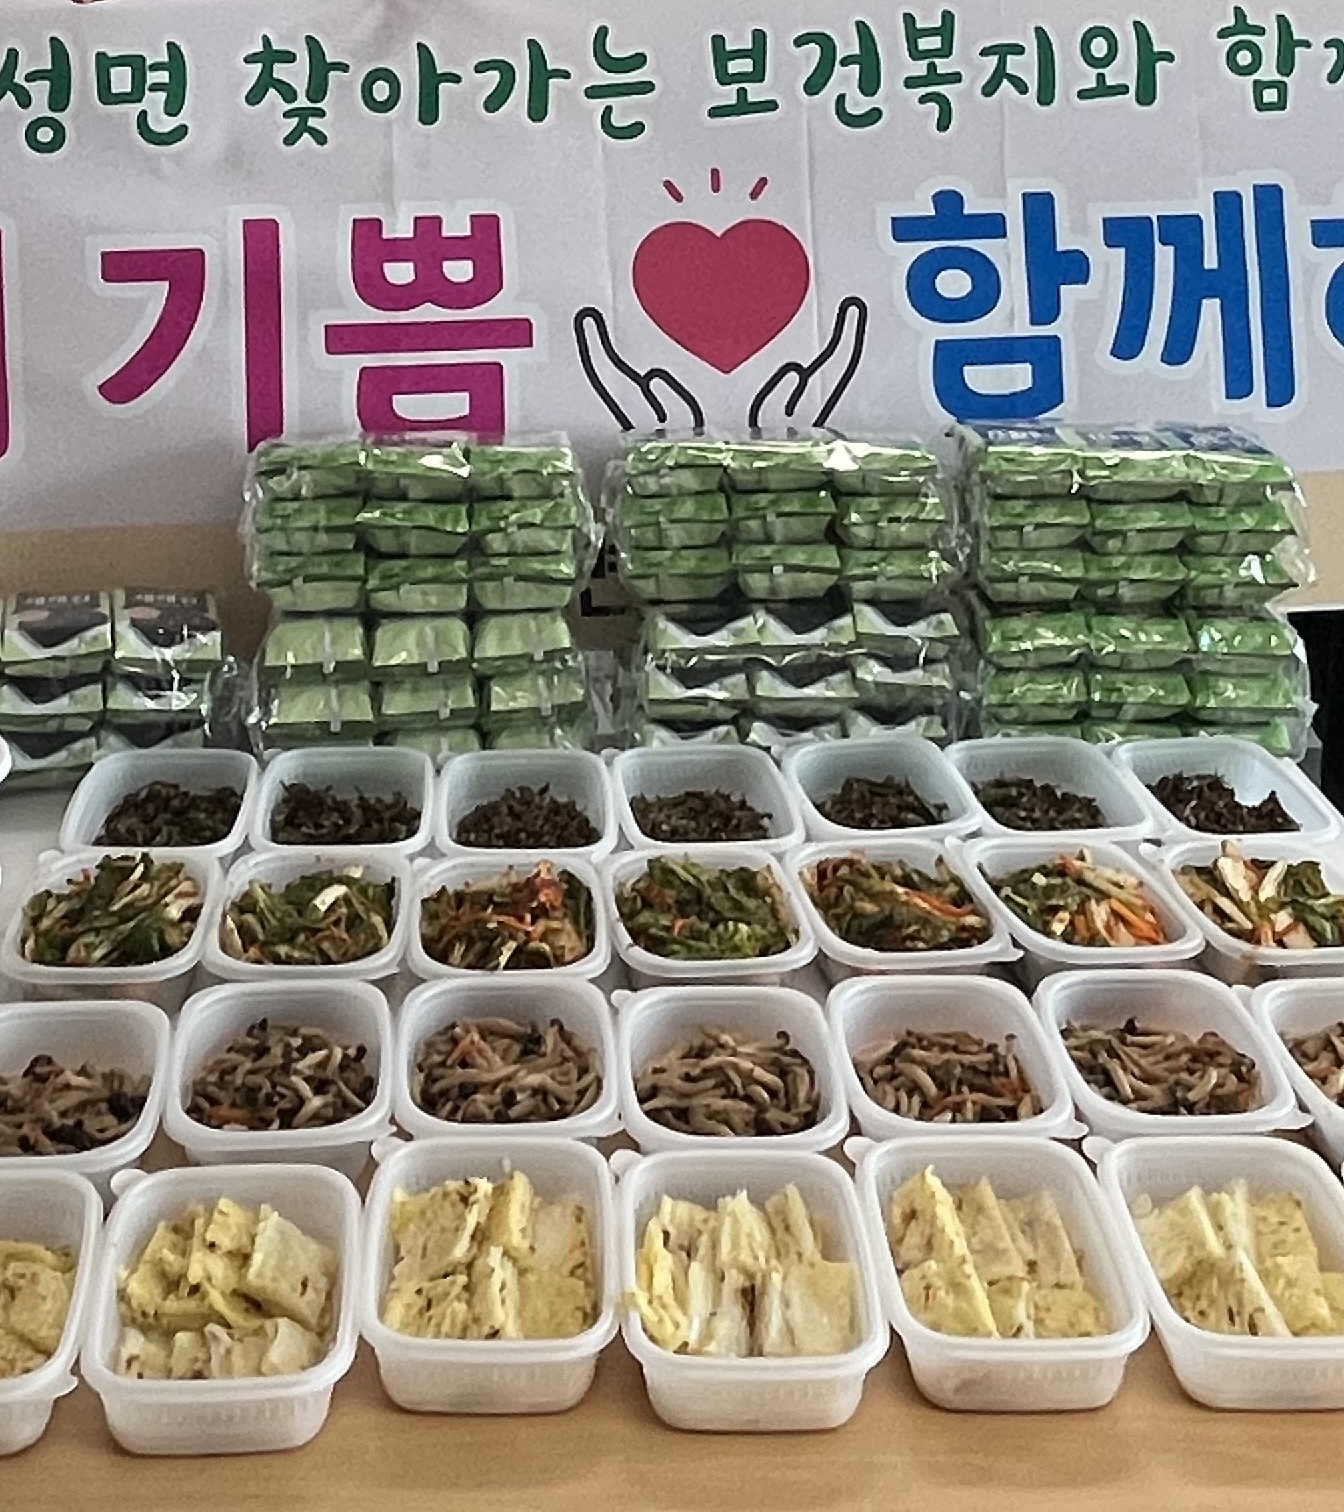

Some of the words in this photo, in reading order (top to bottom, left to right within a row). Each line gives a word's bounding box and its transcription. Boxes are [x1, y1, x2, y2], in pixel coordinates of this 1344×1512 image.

[244, 26, 656, 147] 찾아가는
[707, 10, 1176, 140] 보건복지와
[97, 214, 534, 453] 기쁨
